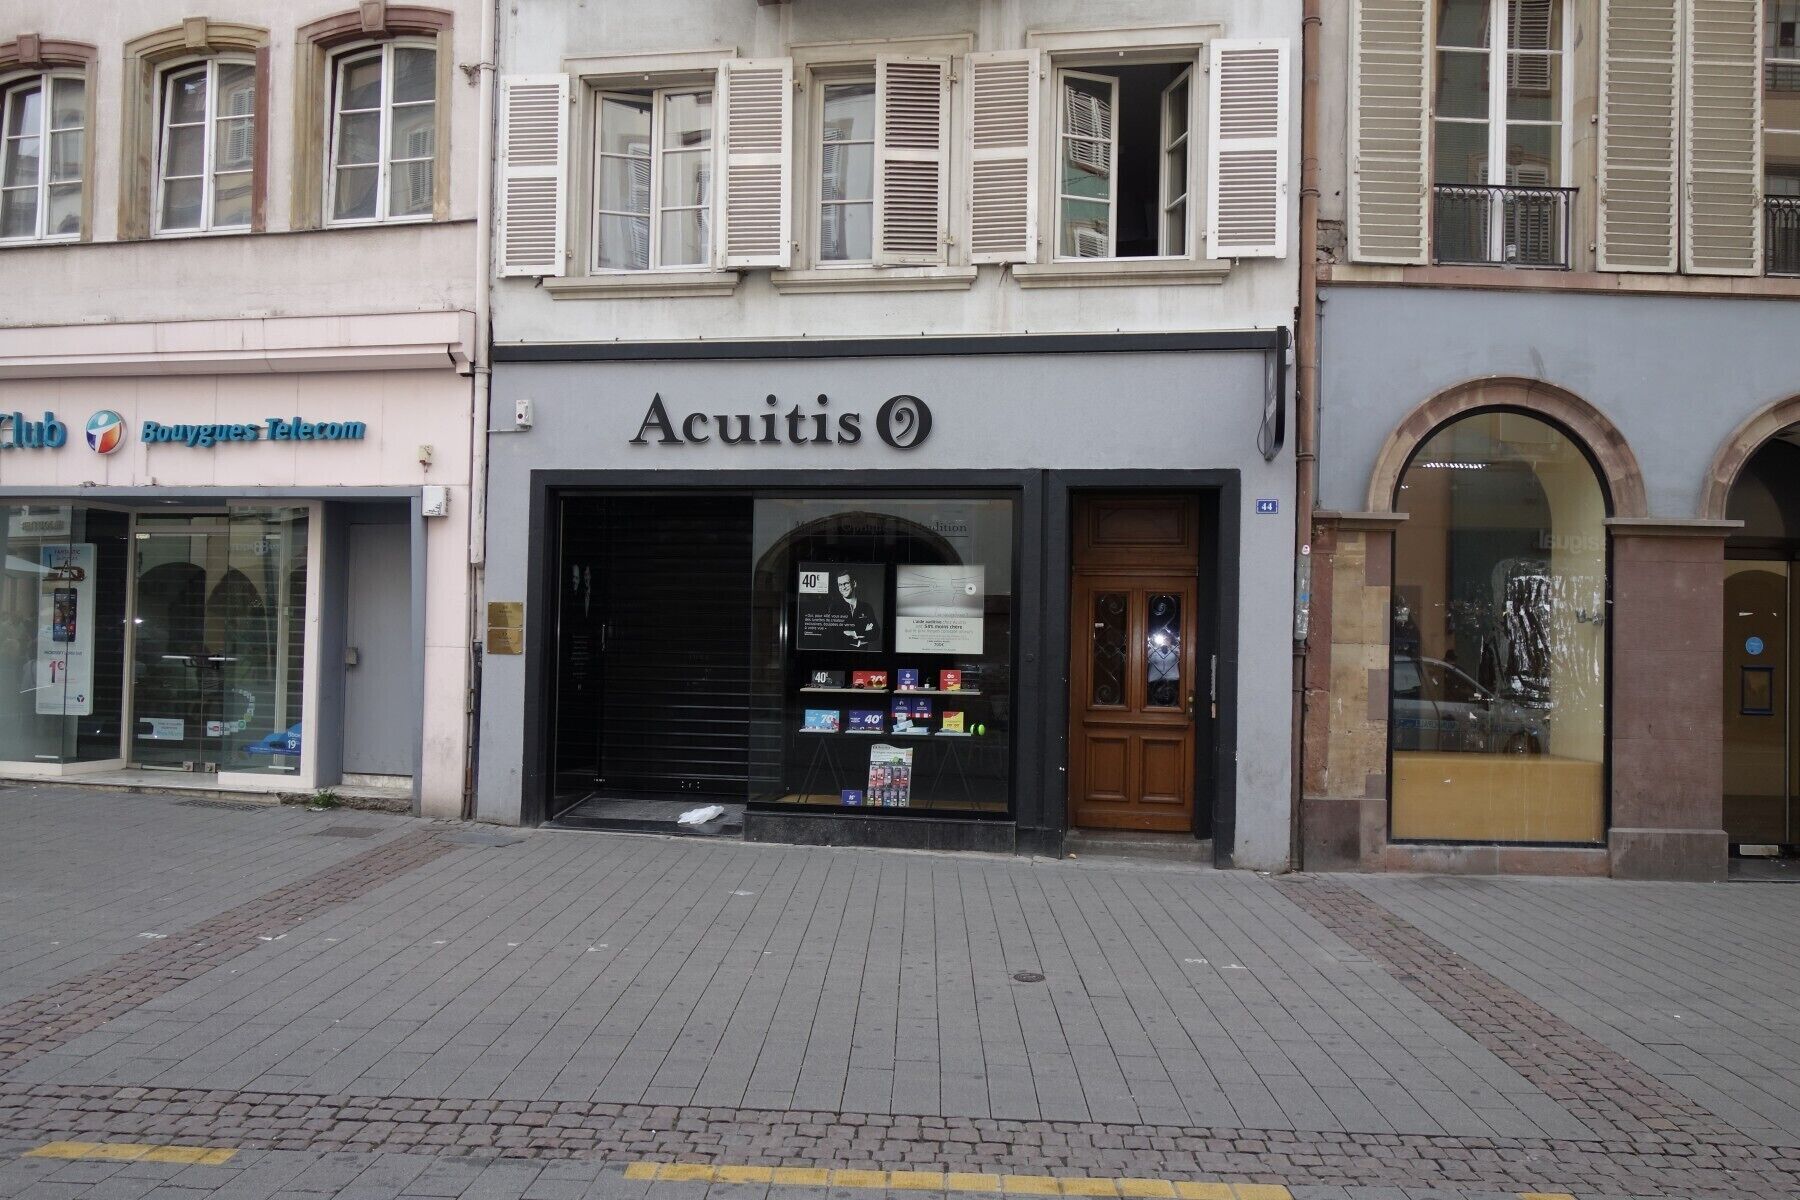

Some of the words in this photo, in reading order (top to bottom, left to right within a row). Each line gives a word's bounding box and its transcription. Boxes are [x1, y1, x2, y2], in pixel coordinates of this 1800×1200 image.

[0, 411, 68, 449] Club
[141, 420, 262, 448] Bouygues
[265, 416, 367, 441] Telecom
[629, 392, 862, 445] Acuitis
[1261, 502, 1273, 511] 44
